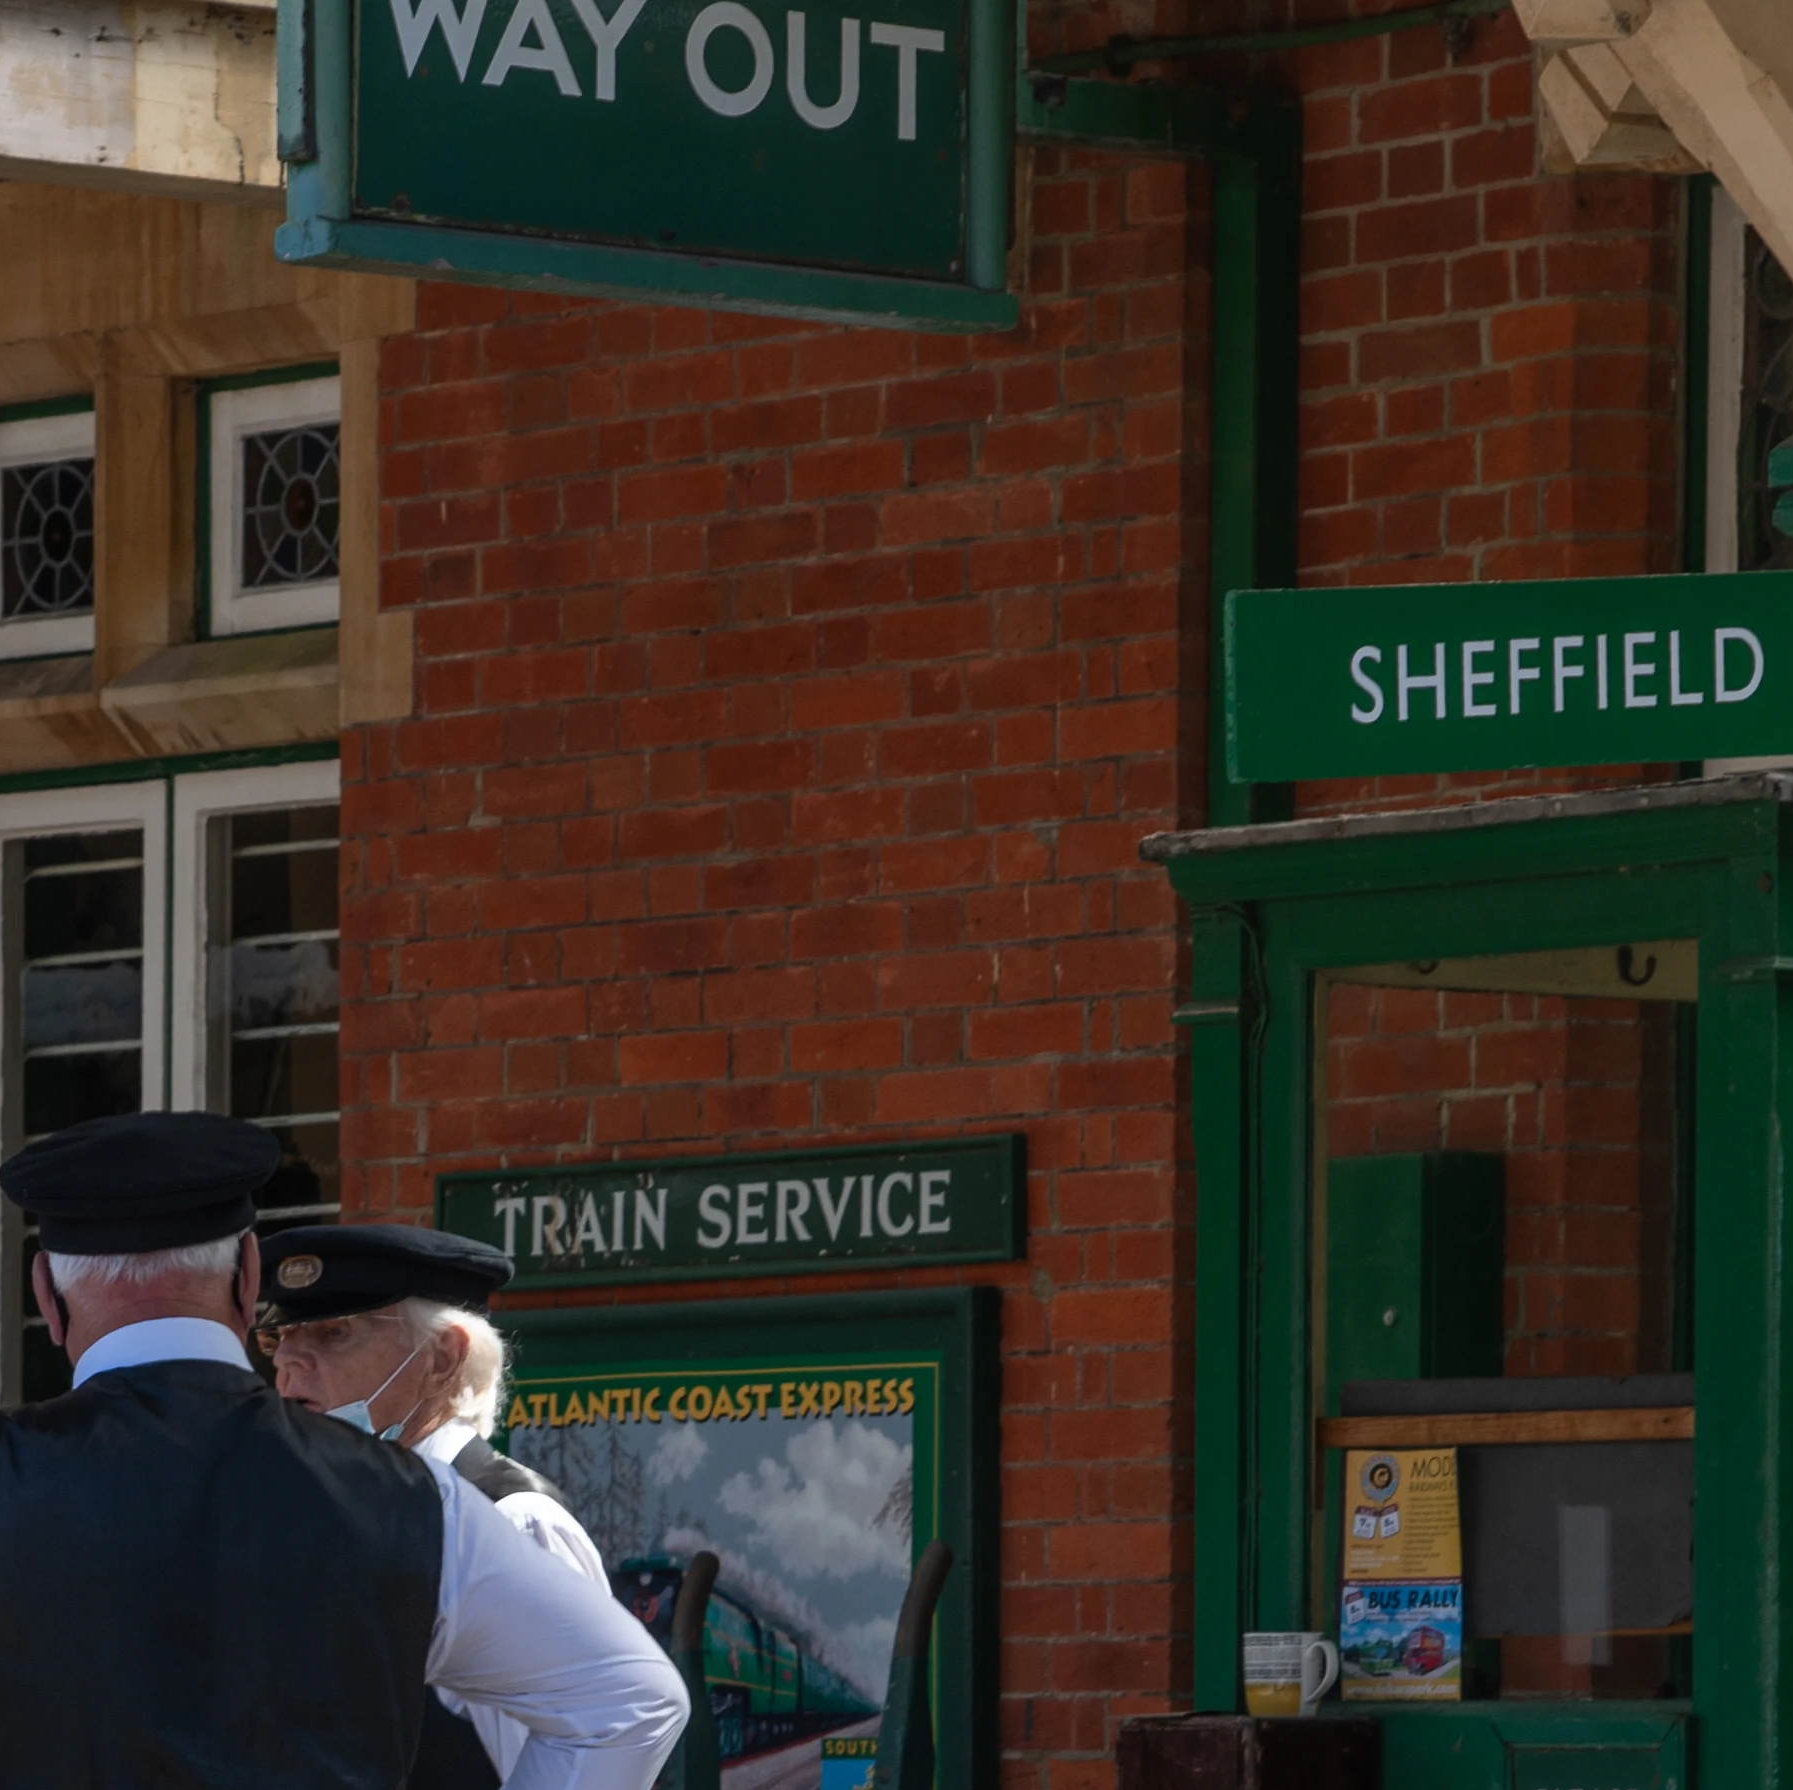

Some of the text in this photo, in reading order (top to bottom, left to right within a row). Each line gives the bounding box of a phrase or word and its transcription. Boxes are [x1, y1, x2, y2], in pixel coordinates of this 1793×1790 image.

[389, 0, 946, 140] WAY OUT
[1349, 626, 1765, 724] SHEFFIELD
[493, 1168, 952, 1257] TRAIN SERVICE
[508, 1377, 916, 1430] ATLANTIC COAST EXPRESS
[1368, 1591, 1401, 1609] BUS
[1407, 1590, 1458, 1609] RALLY
